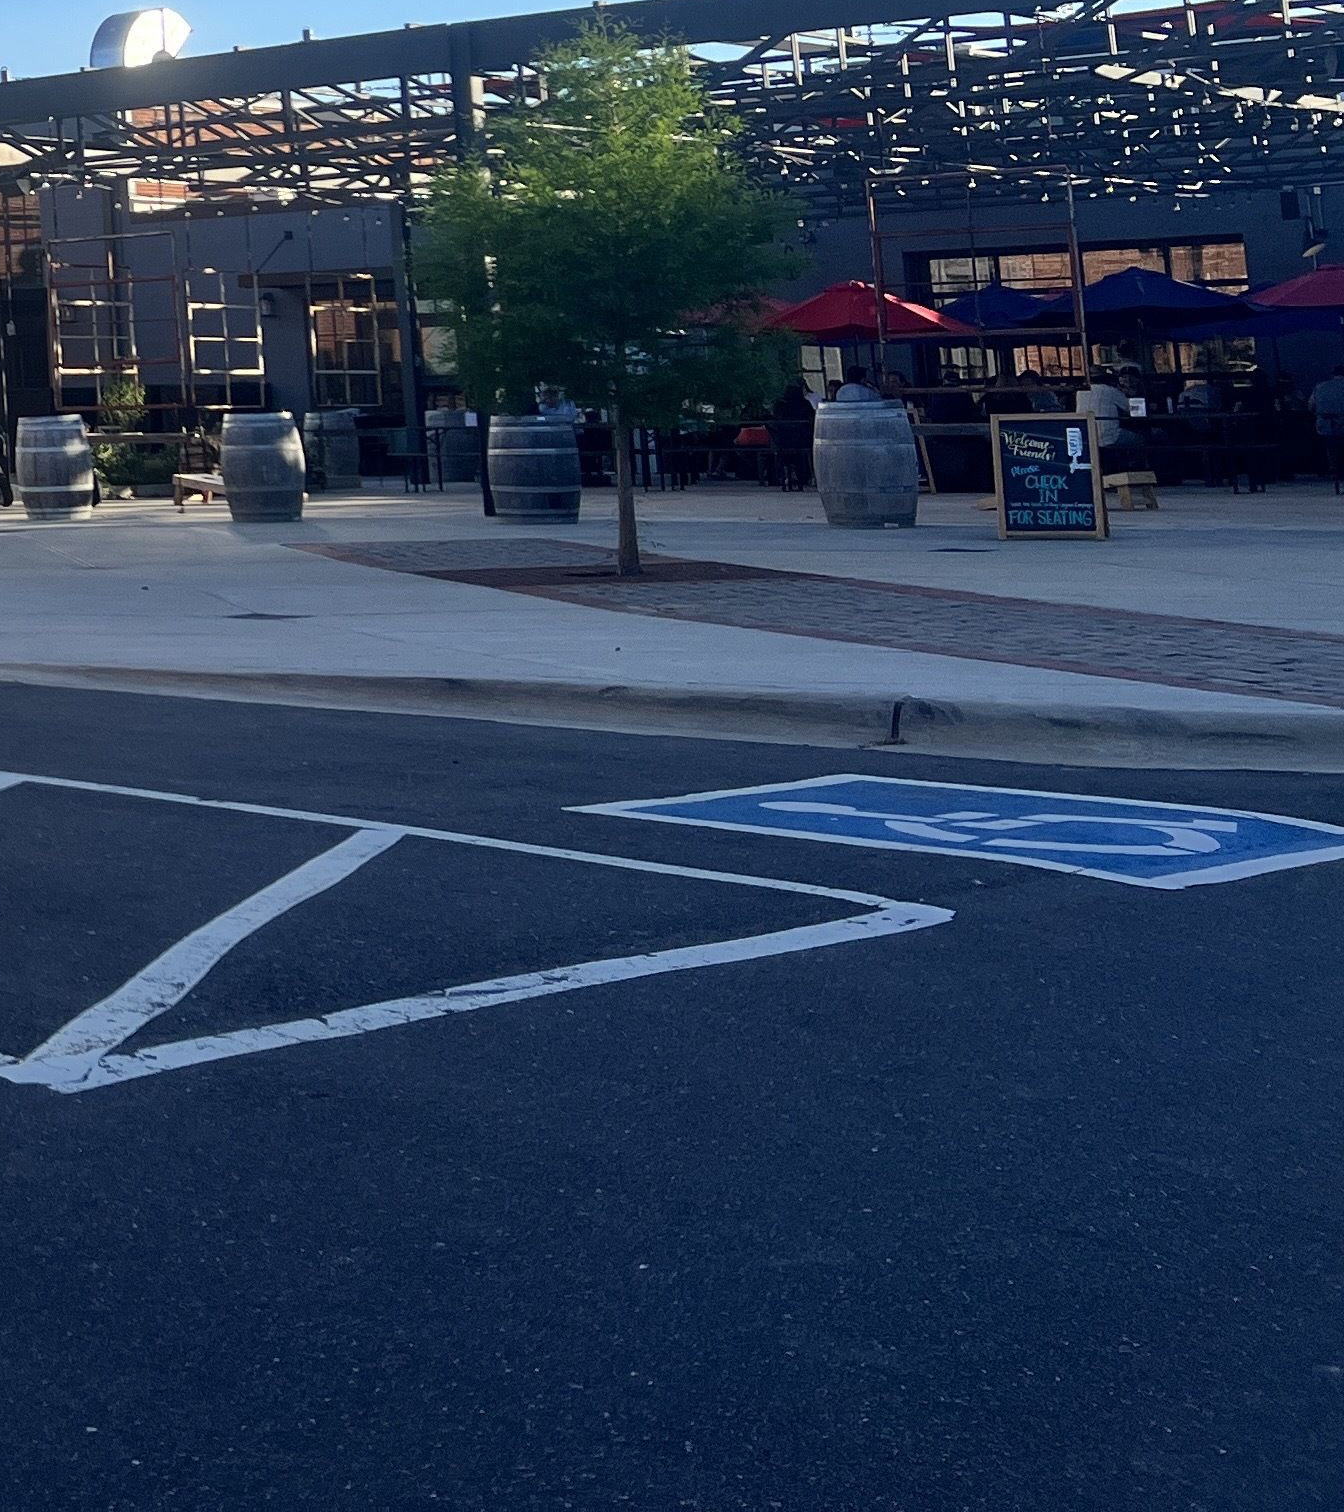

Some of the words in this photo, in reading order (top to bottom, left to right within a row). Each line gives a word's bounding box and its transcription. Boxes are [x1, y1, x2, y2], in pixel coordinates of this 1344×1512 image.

[1025, 475, 1069, 489] CHECK
[1039, 489, 1058, 503] IN
[1008, 510, 1034, 525] FOR
[1037, 510, 1093, 526] SEATING
